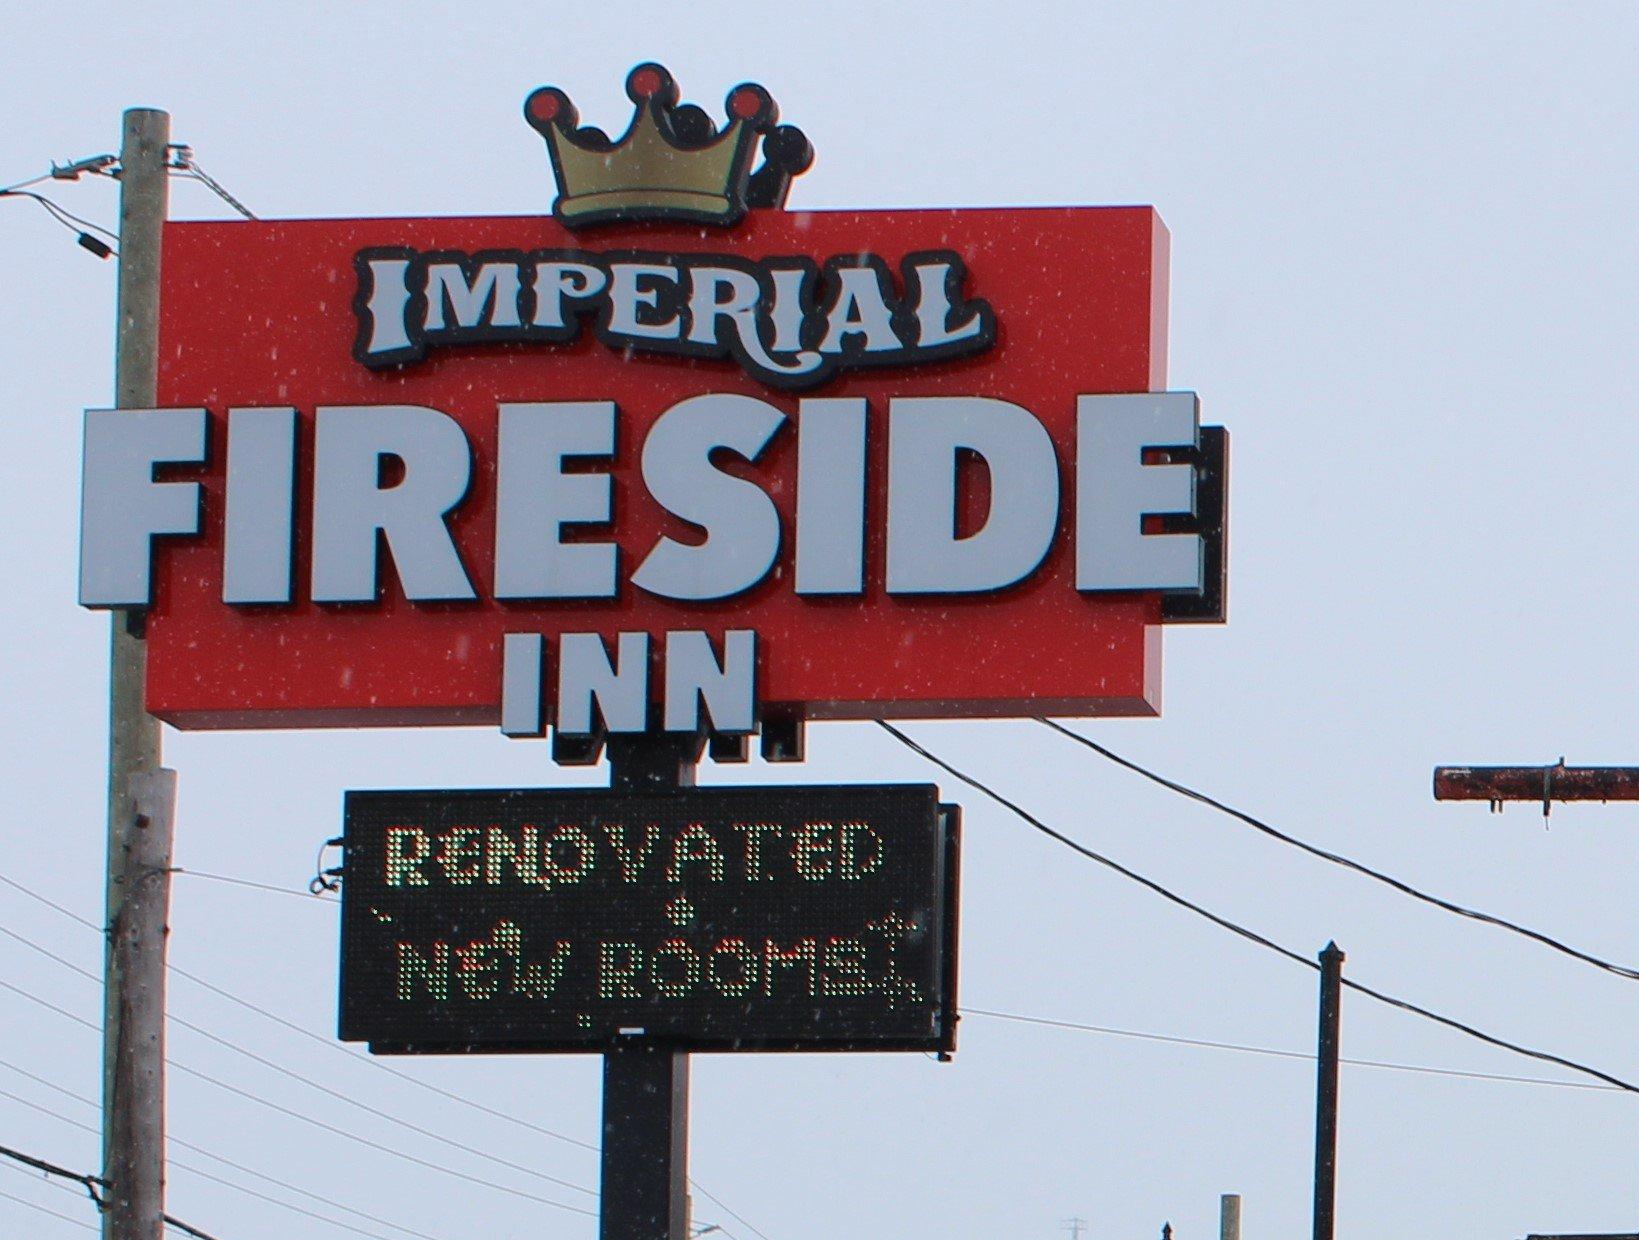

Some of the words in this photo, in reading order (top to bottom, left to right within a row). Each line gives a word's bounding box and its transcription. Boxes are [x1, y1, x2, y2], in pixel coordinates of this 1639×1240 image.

[362, 259, 983, 376] IMPERIAL
[79, 393, 1206, 608] FIRESIDE
[500, 629, 757, 738] INN
[385, 820, 885, 890] RENOVATED
[396, 938, 571, 1000] NEW
